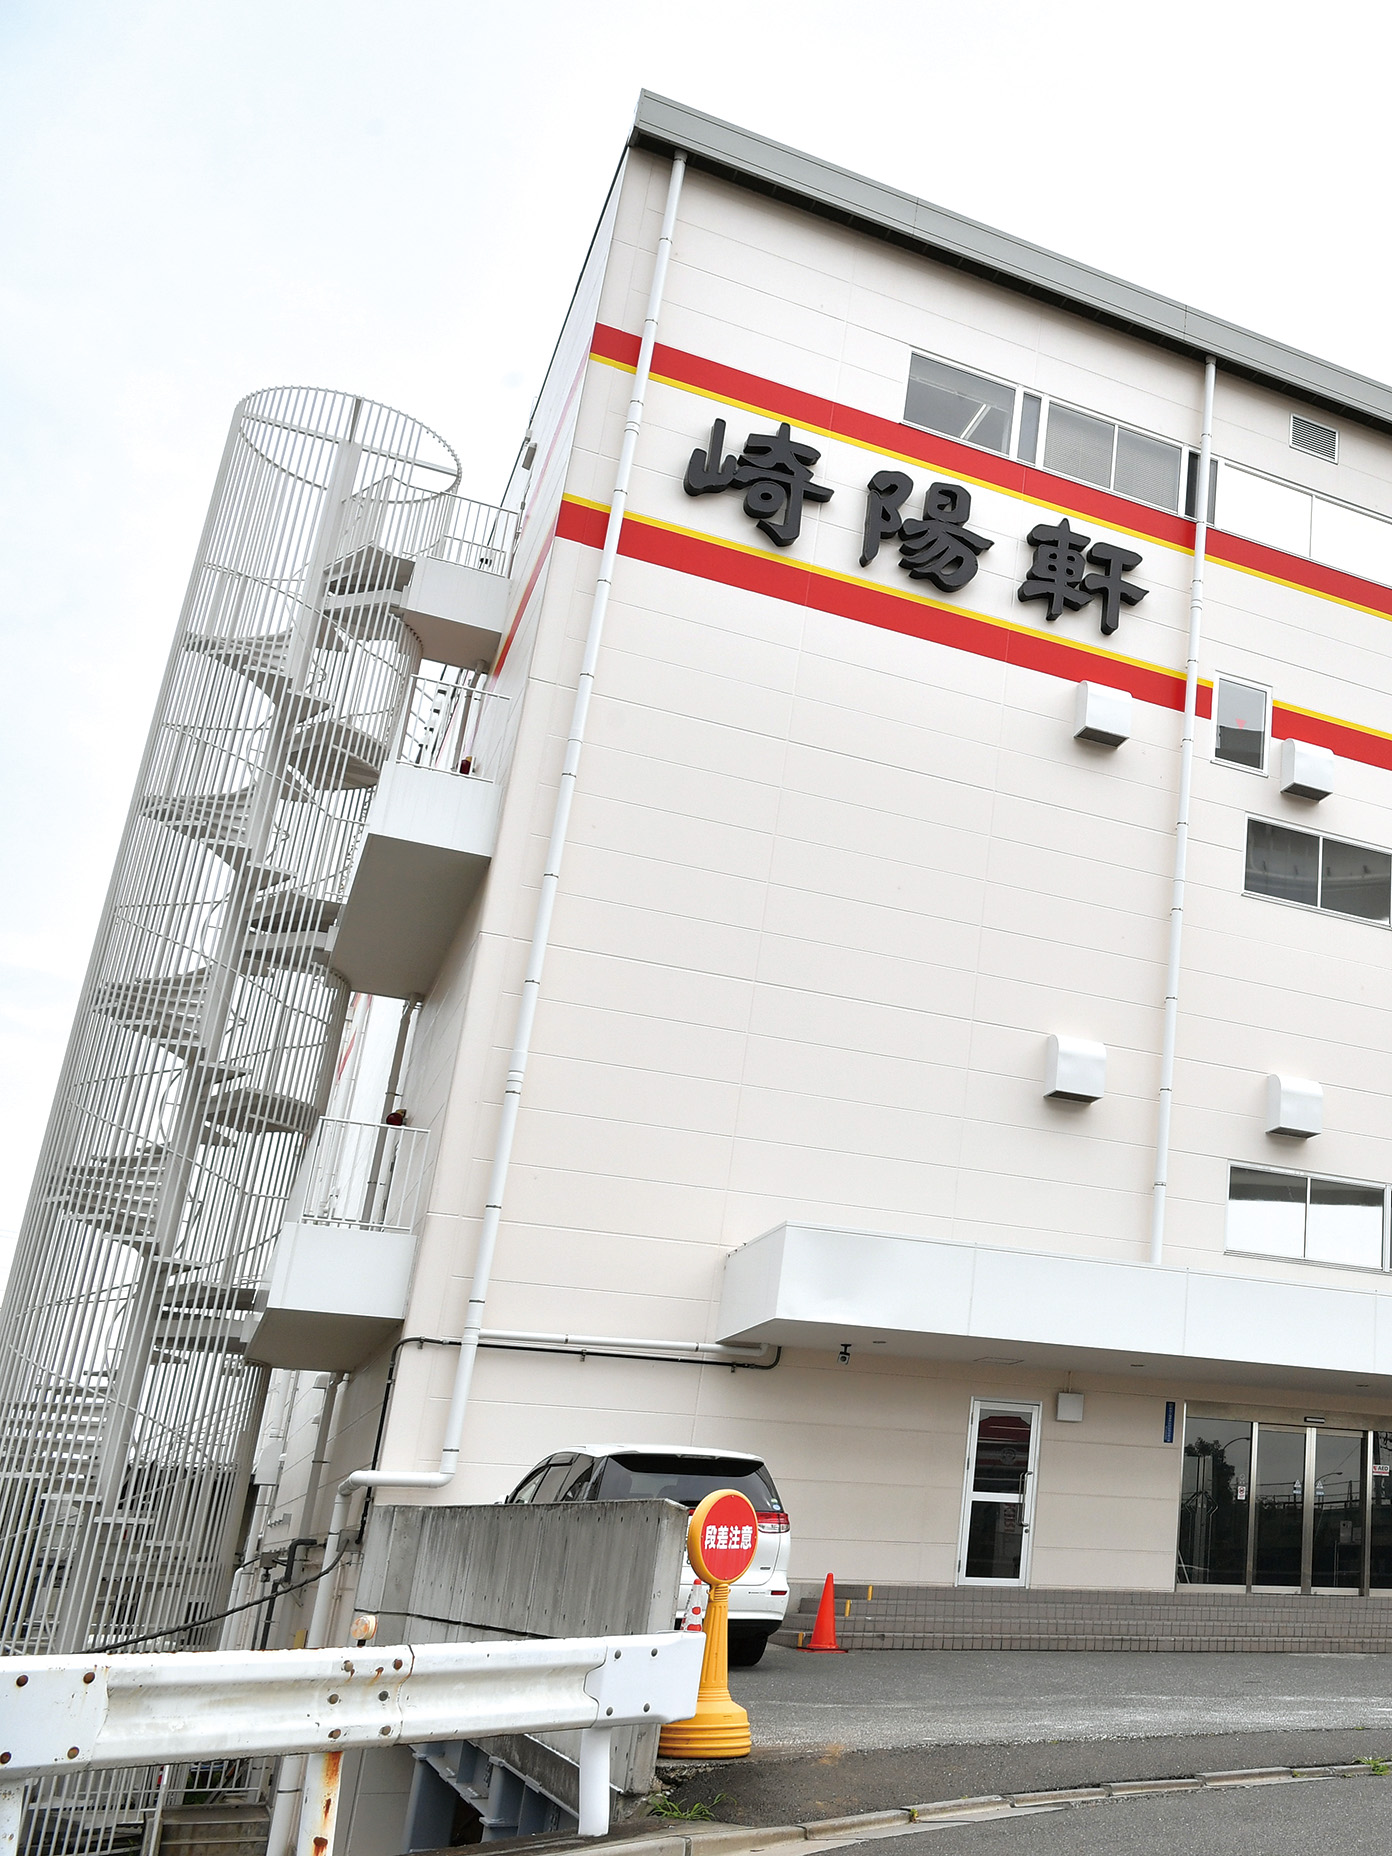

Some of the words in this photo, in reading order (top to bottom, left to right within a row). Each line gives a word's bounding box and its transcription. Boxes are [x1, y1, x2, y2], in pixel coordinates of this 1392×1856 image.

[683, 418, 1149, 636] 崎陽軒
[704, 1525, 753, 1550] 段差注意
